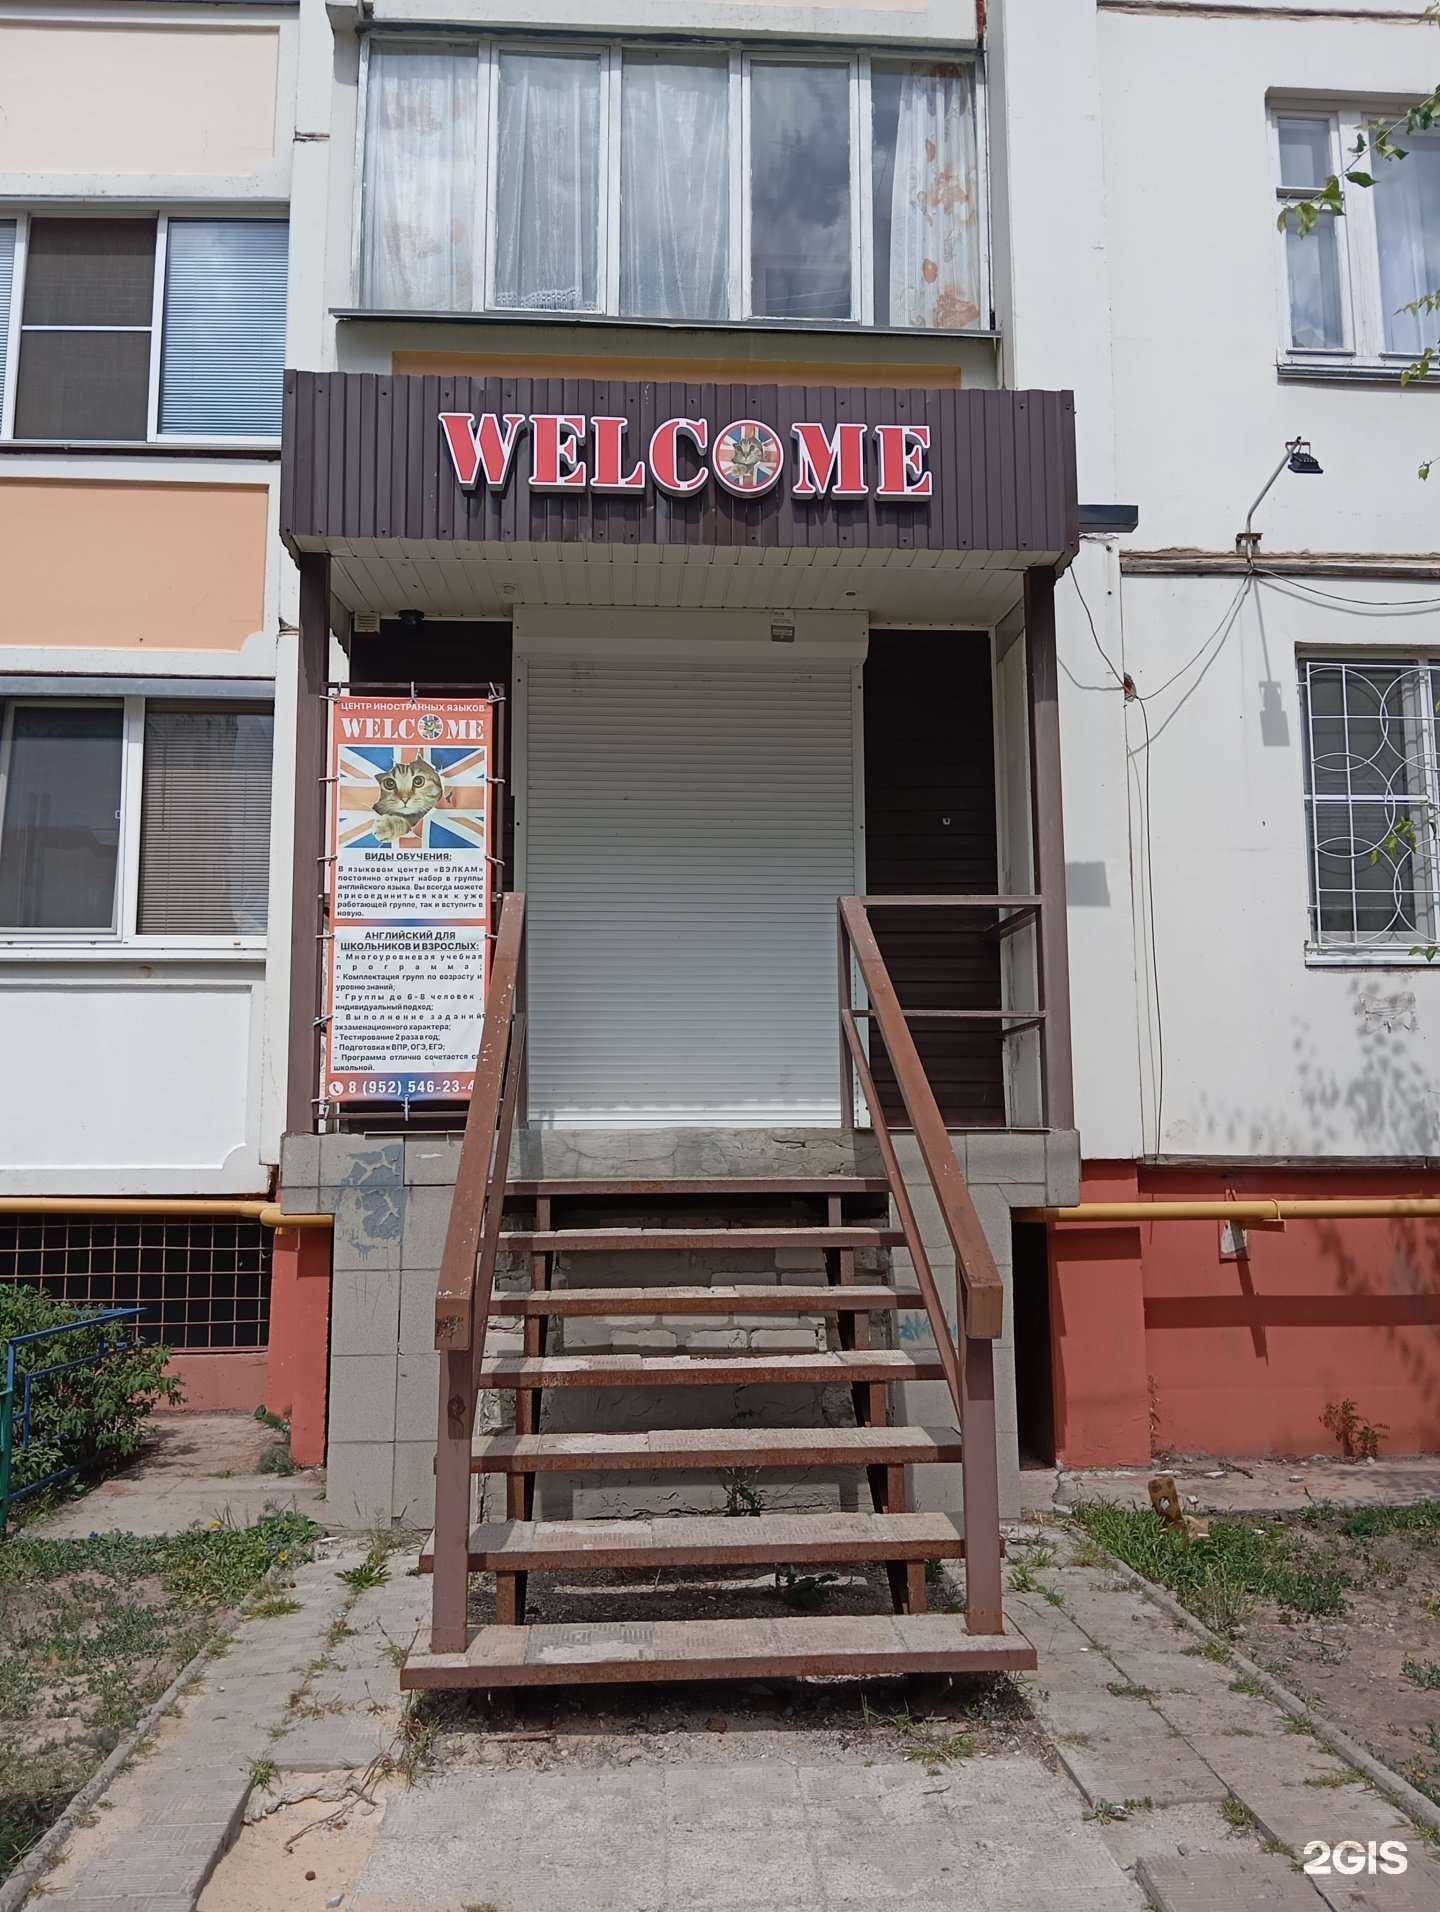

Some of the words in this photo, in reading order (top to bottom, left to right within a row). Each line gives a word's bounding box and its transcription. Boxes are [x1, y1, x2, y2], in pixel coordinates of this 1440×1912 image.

[438, 412, 933, 500] WELCOME
[341, 702, 372, 711] ЦЕНТР
[373, 703, 444, 711] ИНОСТРАННЫХ
[341, 714, 484, 740] WELCOME
[365, 852, 394, 861] ВИДЫ
[396, 853, 452, 861] ОБУЧЕНИЯ:
[418, 875, 443, 883] набор
[337, 901, 388, 909] работающей
[365, 931, 433, 940] АНГЛИЙСКИЙ
[434, 932, 456, 940] ДЛЯ
[340, 943, 412, 951] ШКОЛЬНИКОВ
[422, 943, 480, 951] ВЗРОСЛЫХ:
[402, 974, 425, 982] групп
[336, 984, 366, 992] уровню
[345, 993, 384, 1002] Группы
[335, 1003, 403, 1011] индивидуальный
[340, 1033, 394, 1042] Тестирование
[339, 1043, 385, 1051] Подготовка
[341, 1054, 386, 1062] Программа
[348, 1082, 356, 1093] 8
[362, 1080, 402, 1094] (952)
